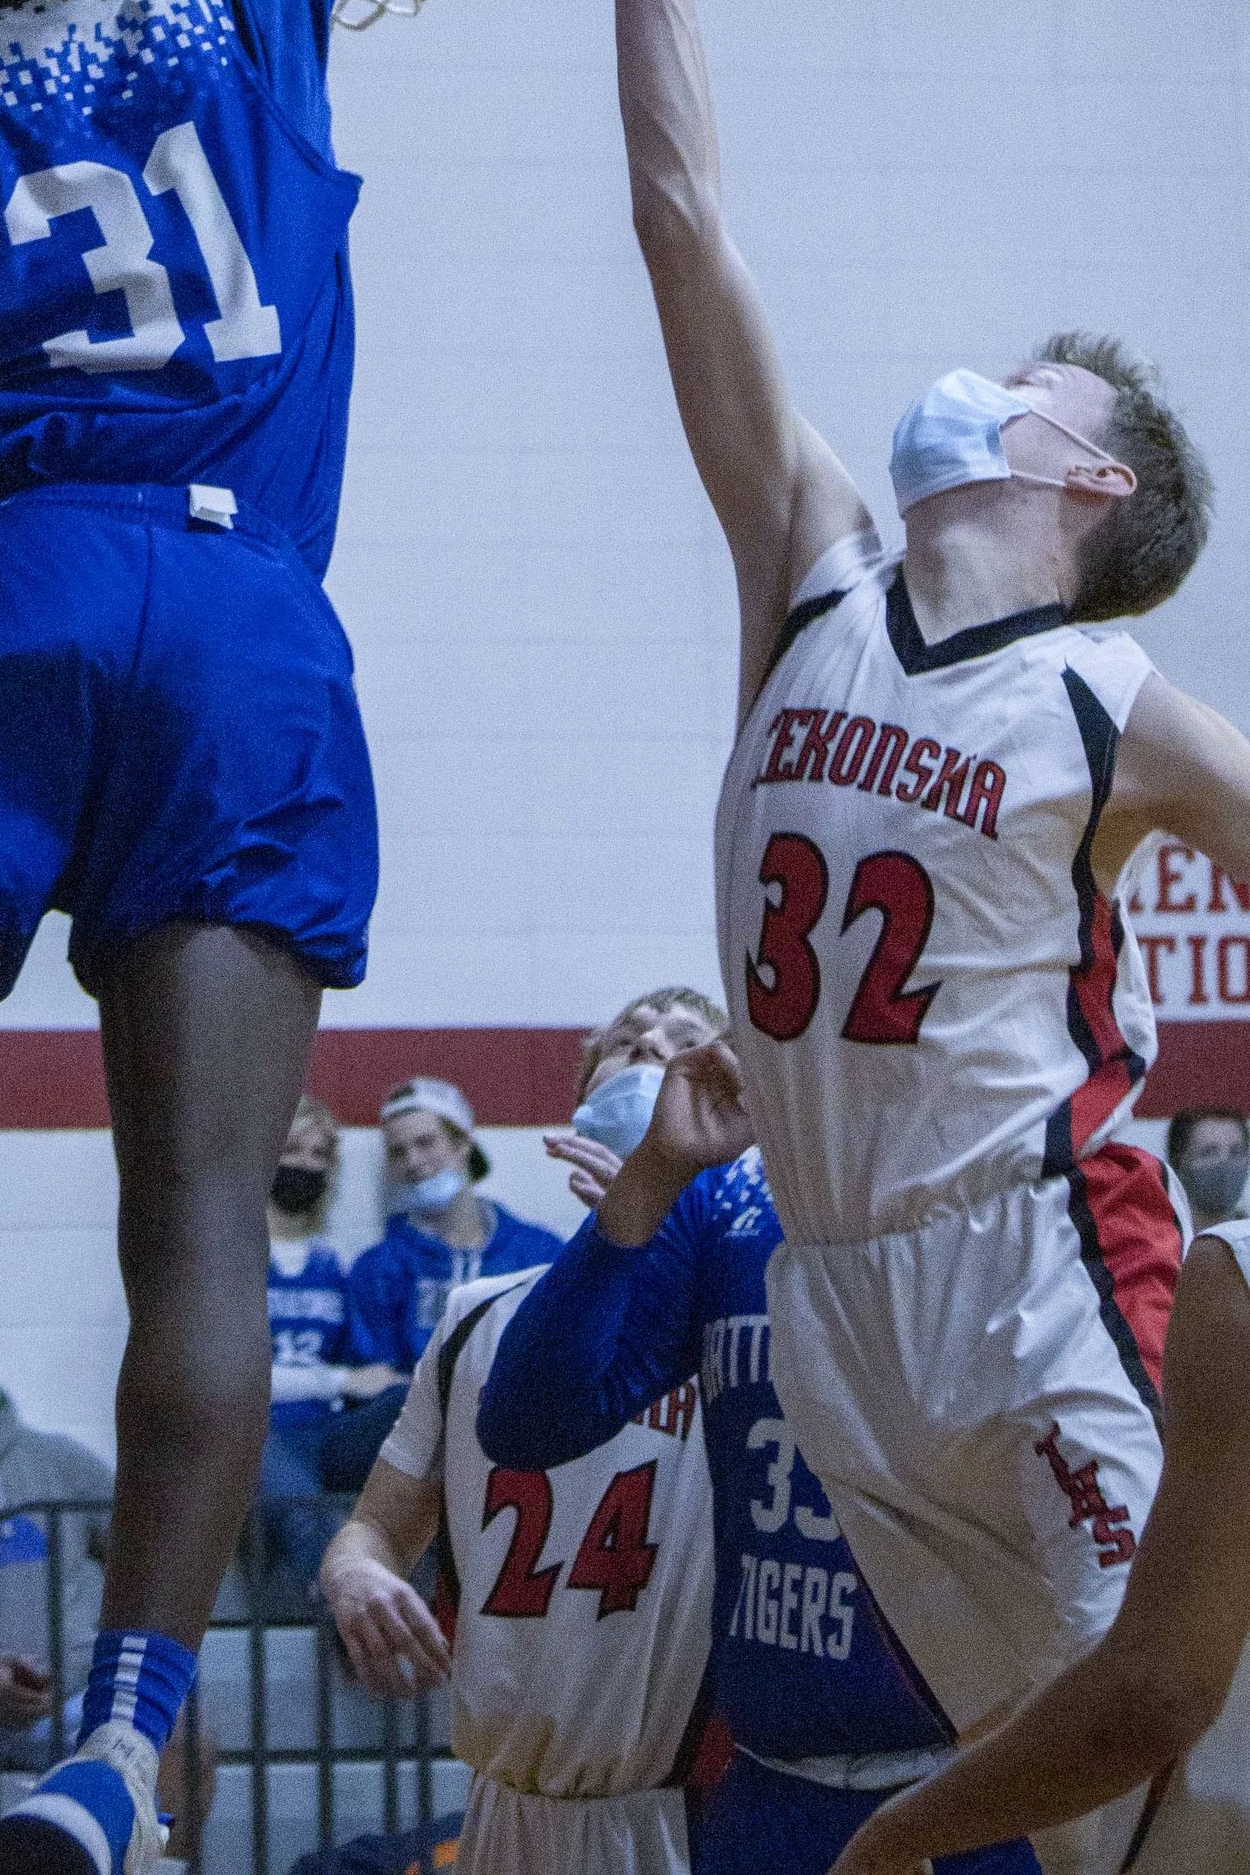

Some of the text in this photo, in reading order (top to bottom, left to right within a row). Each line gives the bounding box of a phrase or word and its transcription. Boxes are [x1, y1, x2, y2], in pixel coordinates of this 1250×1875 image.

[3, 119, 283, 374] 31
[744, 830, 941, 1046] 32
[480, 1458, 660, 1619] 24
[727, 1552, 858, 1662] TIGERS
